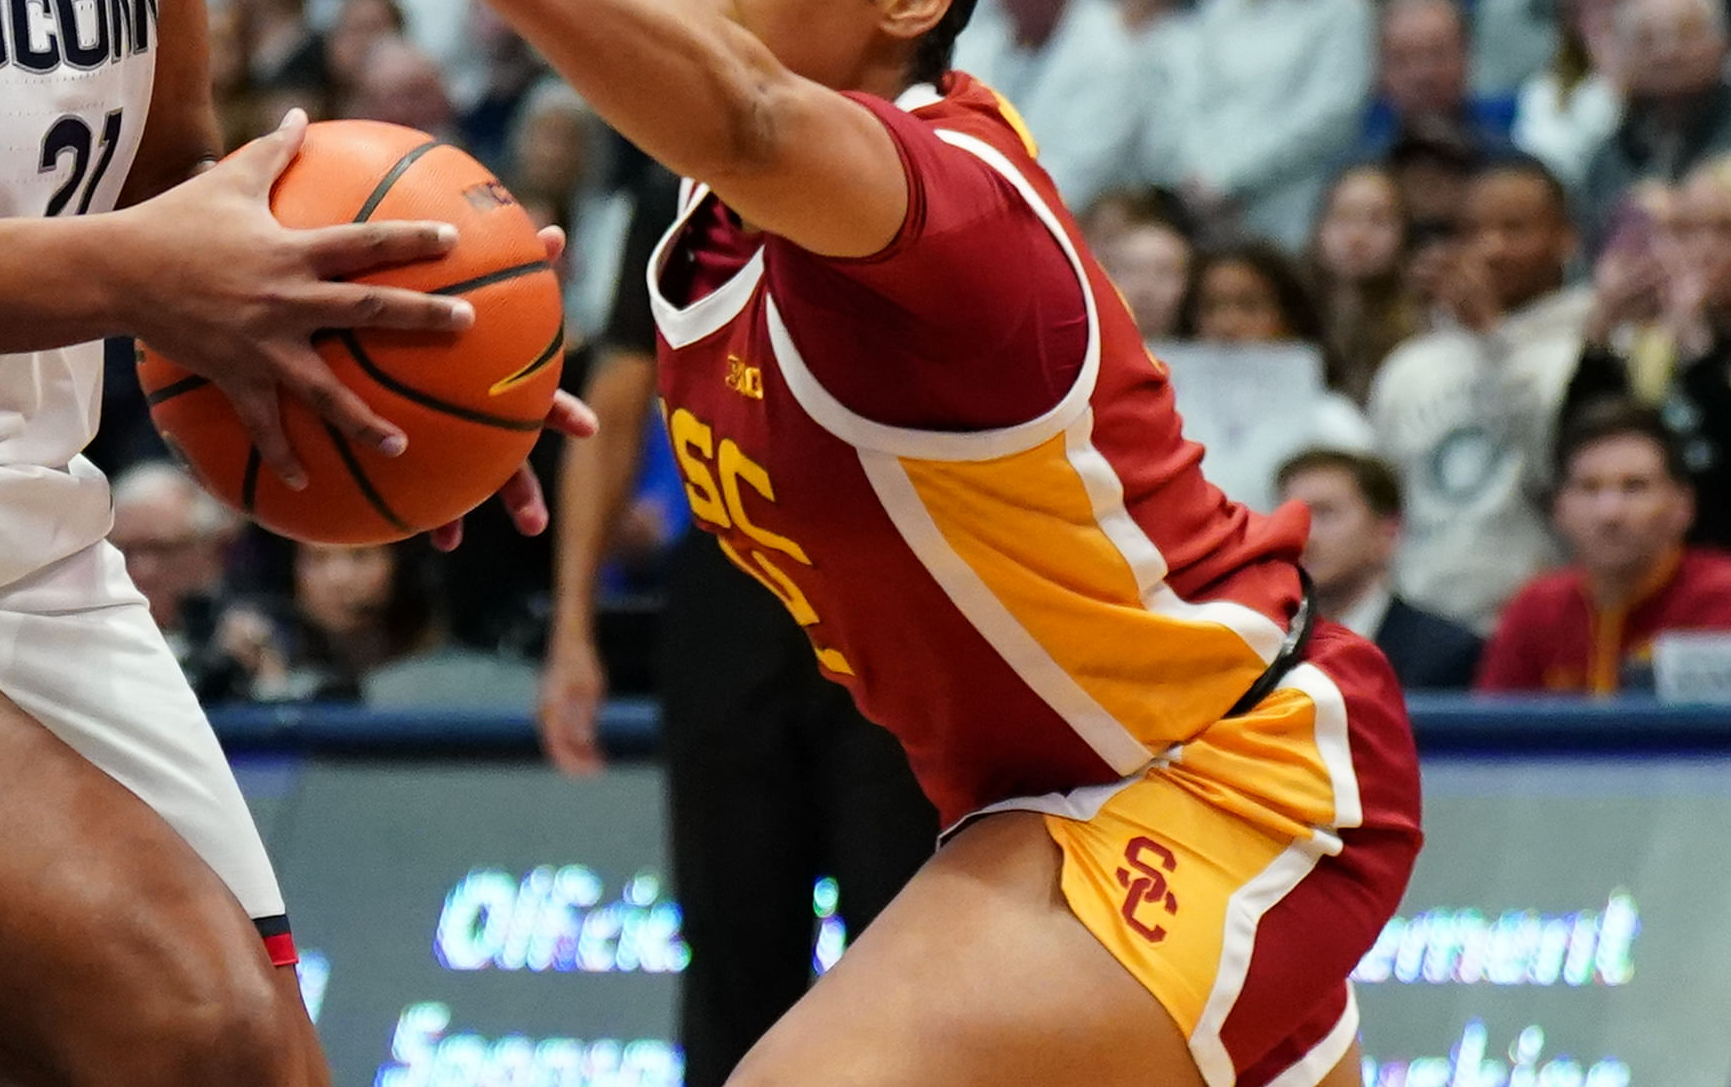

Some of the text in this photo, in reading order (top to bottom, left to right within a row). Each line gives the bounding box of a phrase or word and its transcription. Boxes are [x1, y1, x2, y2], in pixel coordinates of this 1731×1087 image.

[37, 108, 124, 217] 21
[659, 396, 812, 566] SC
[1115, 836, 1179, 943] SC
